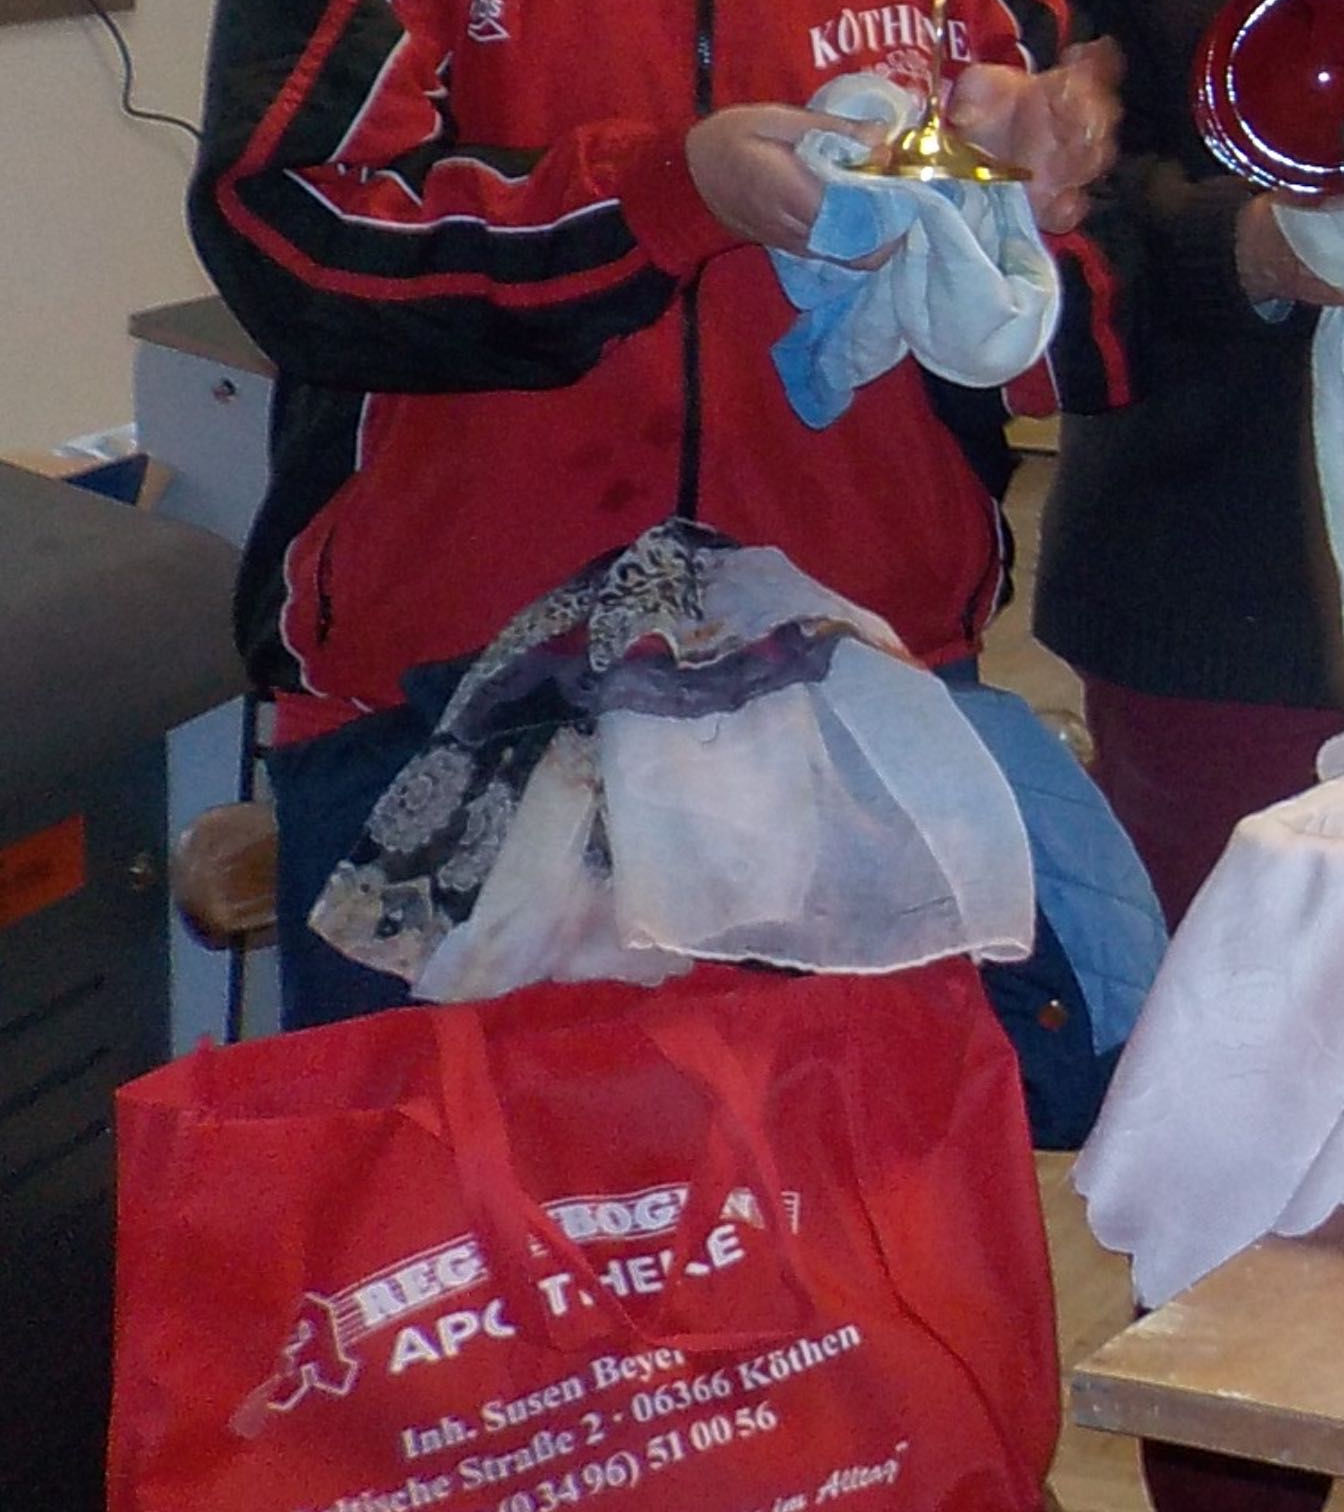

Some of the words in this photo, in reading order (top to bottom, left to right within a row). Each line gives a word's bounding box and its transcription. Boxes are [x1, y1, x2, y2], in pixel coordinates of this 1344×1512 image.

[401, 1416, 478, 1459] Inh.
[481, 1376, 583, 1433] Susen
[458, 1430, 575, 1489] Straße
[580, 1411, 606, 1445] 2
[631, 1368, 732, 1423] 06366
[737, 1324, 862, 1390] Köthen
